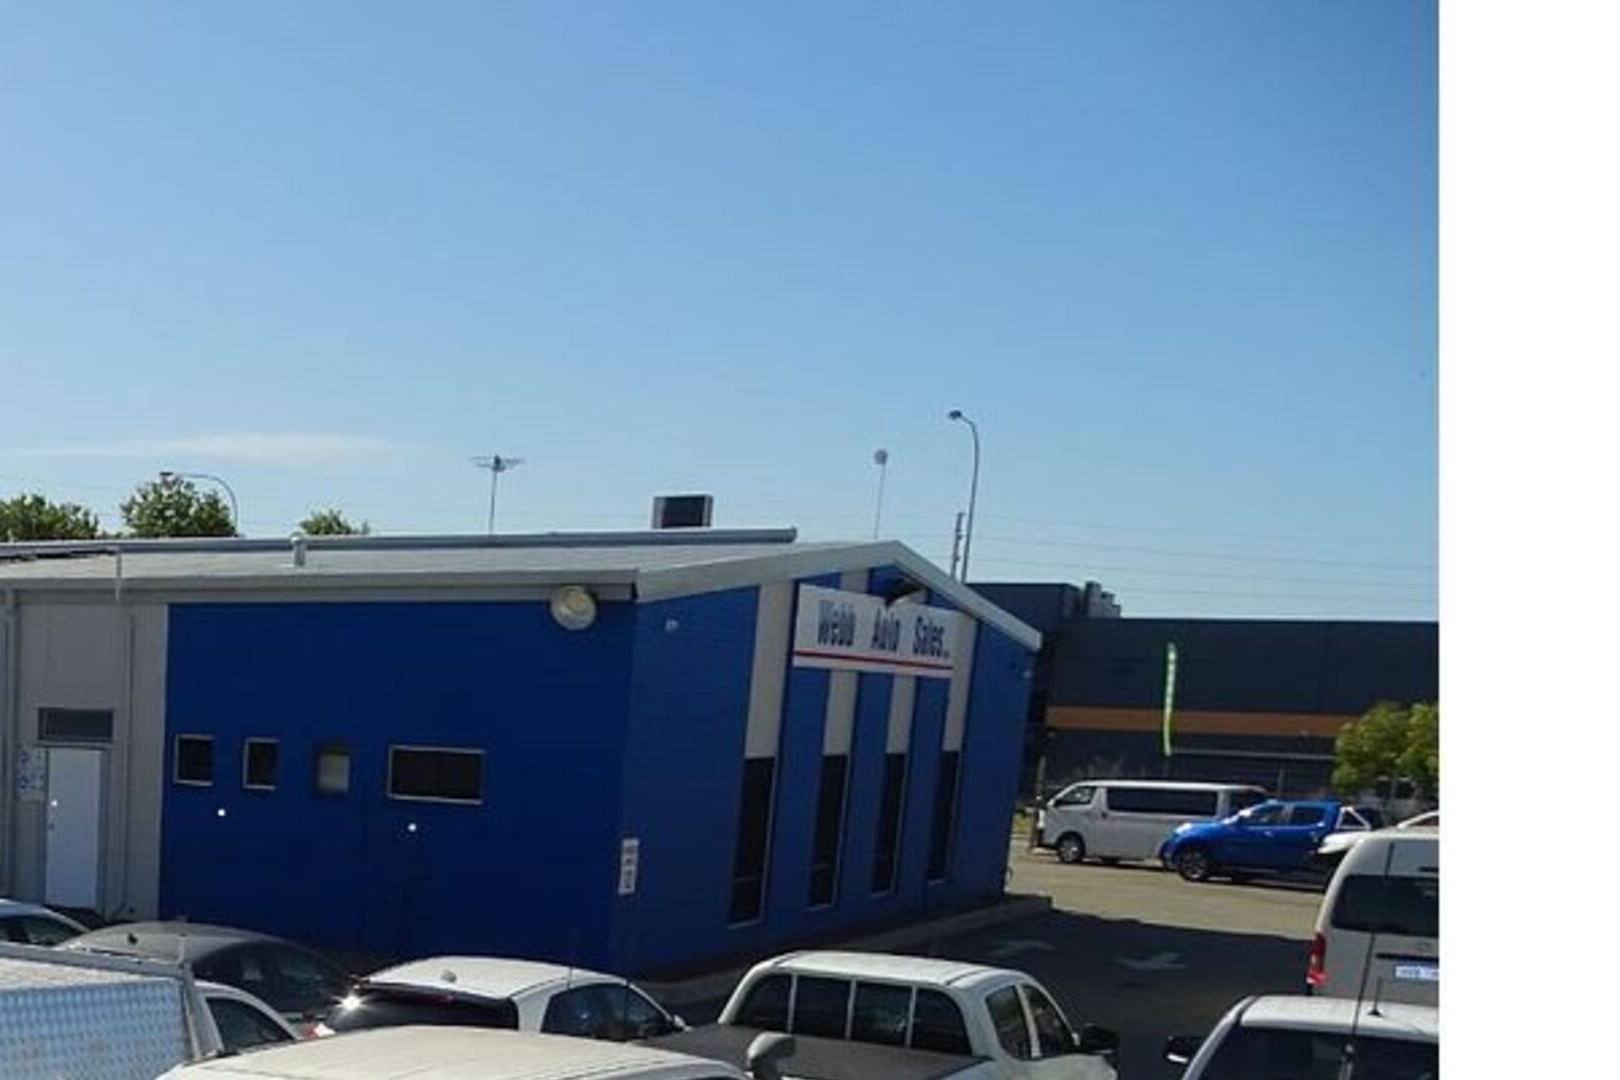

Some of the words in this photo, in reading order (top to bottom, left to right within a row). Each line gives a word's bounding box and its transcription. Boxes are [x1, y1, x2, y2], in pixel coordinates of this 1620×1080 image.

[817, 600, 855, 646] Webb
[871, 605, 900, 652] Auto
[912, 614, 944, 657] Sales
